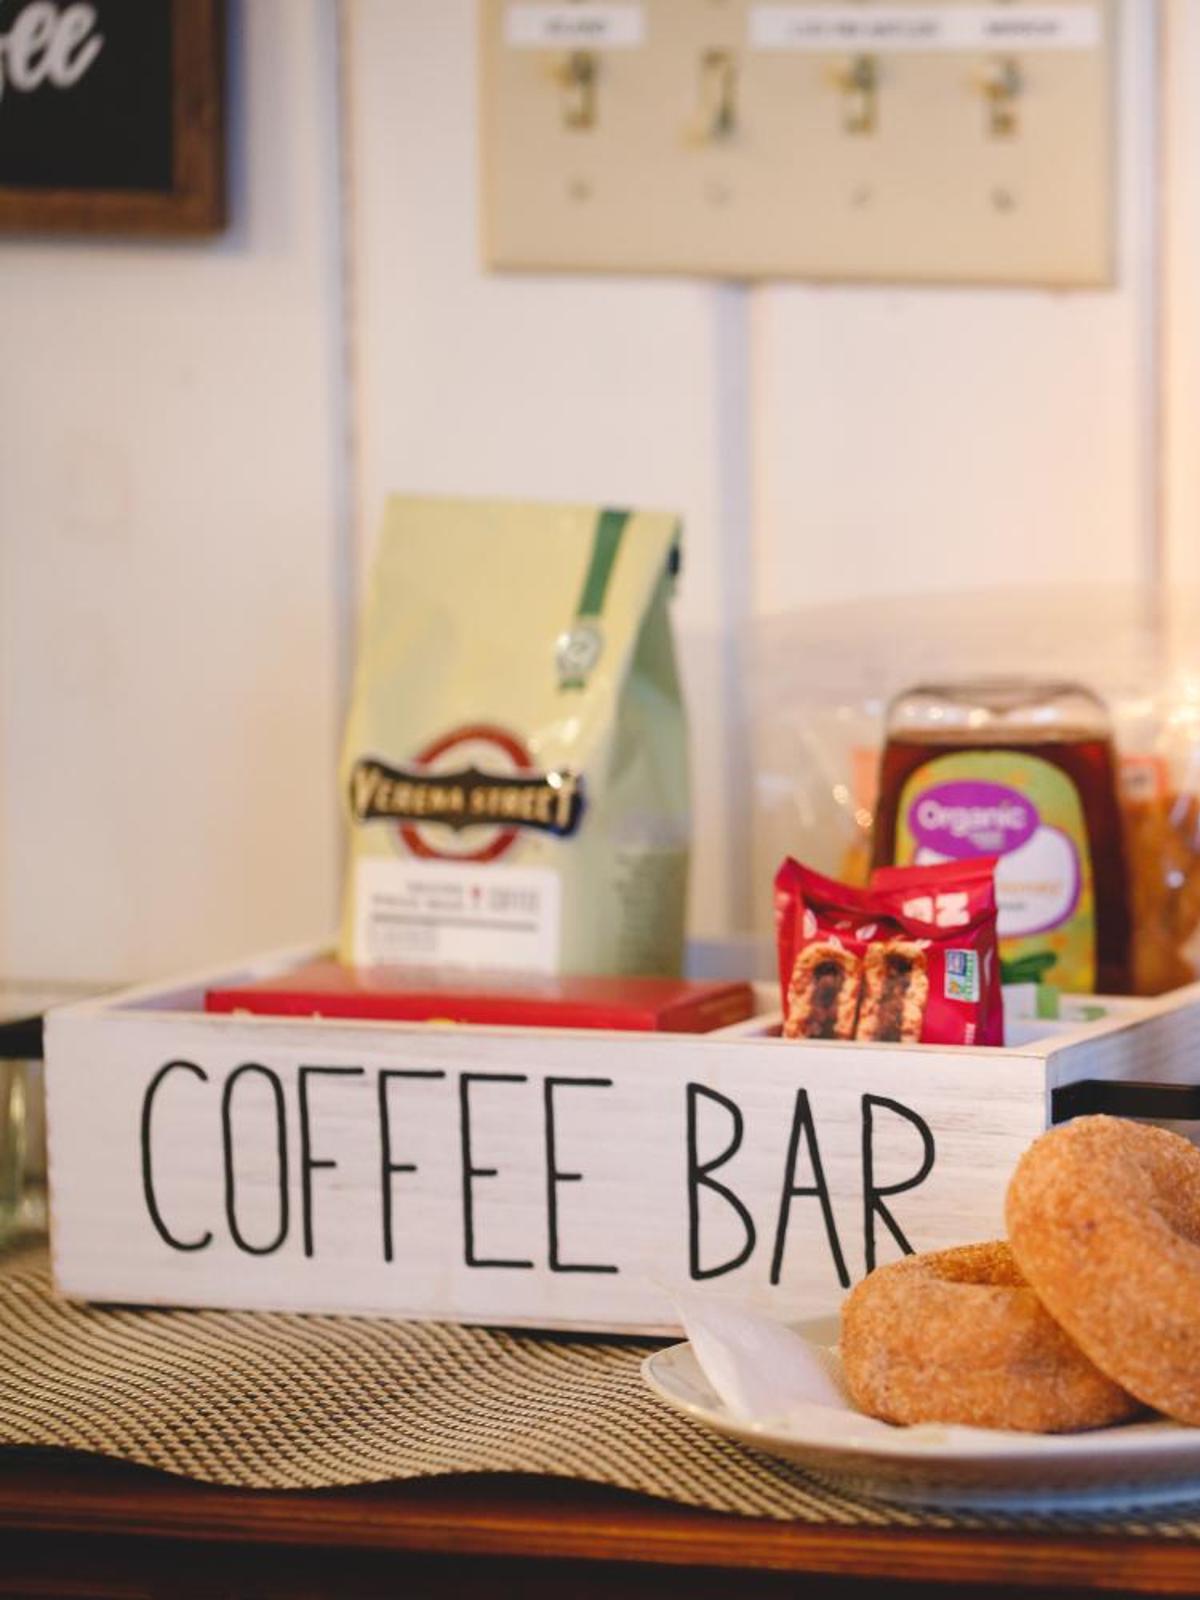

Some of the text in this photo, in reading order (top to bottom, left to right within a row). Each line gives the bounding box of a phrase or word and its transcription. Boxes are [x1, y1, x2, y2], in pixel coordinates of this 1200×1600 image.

[0, 0, 103, 92] ee
[916, 799, 1028, 837] Organic
[140, 1058, 936, 1288] COFFEE BAR
